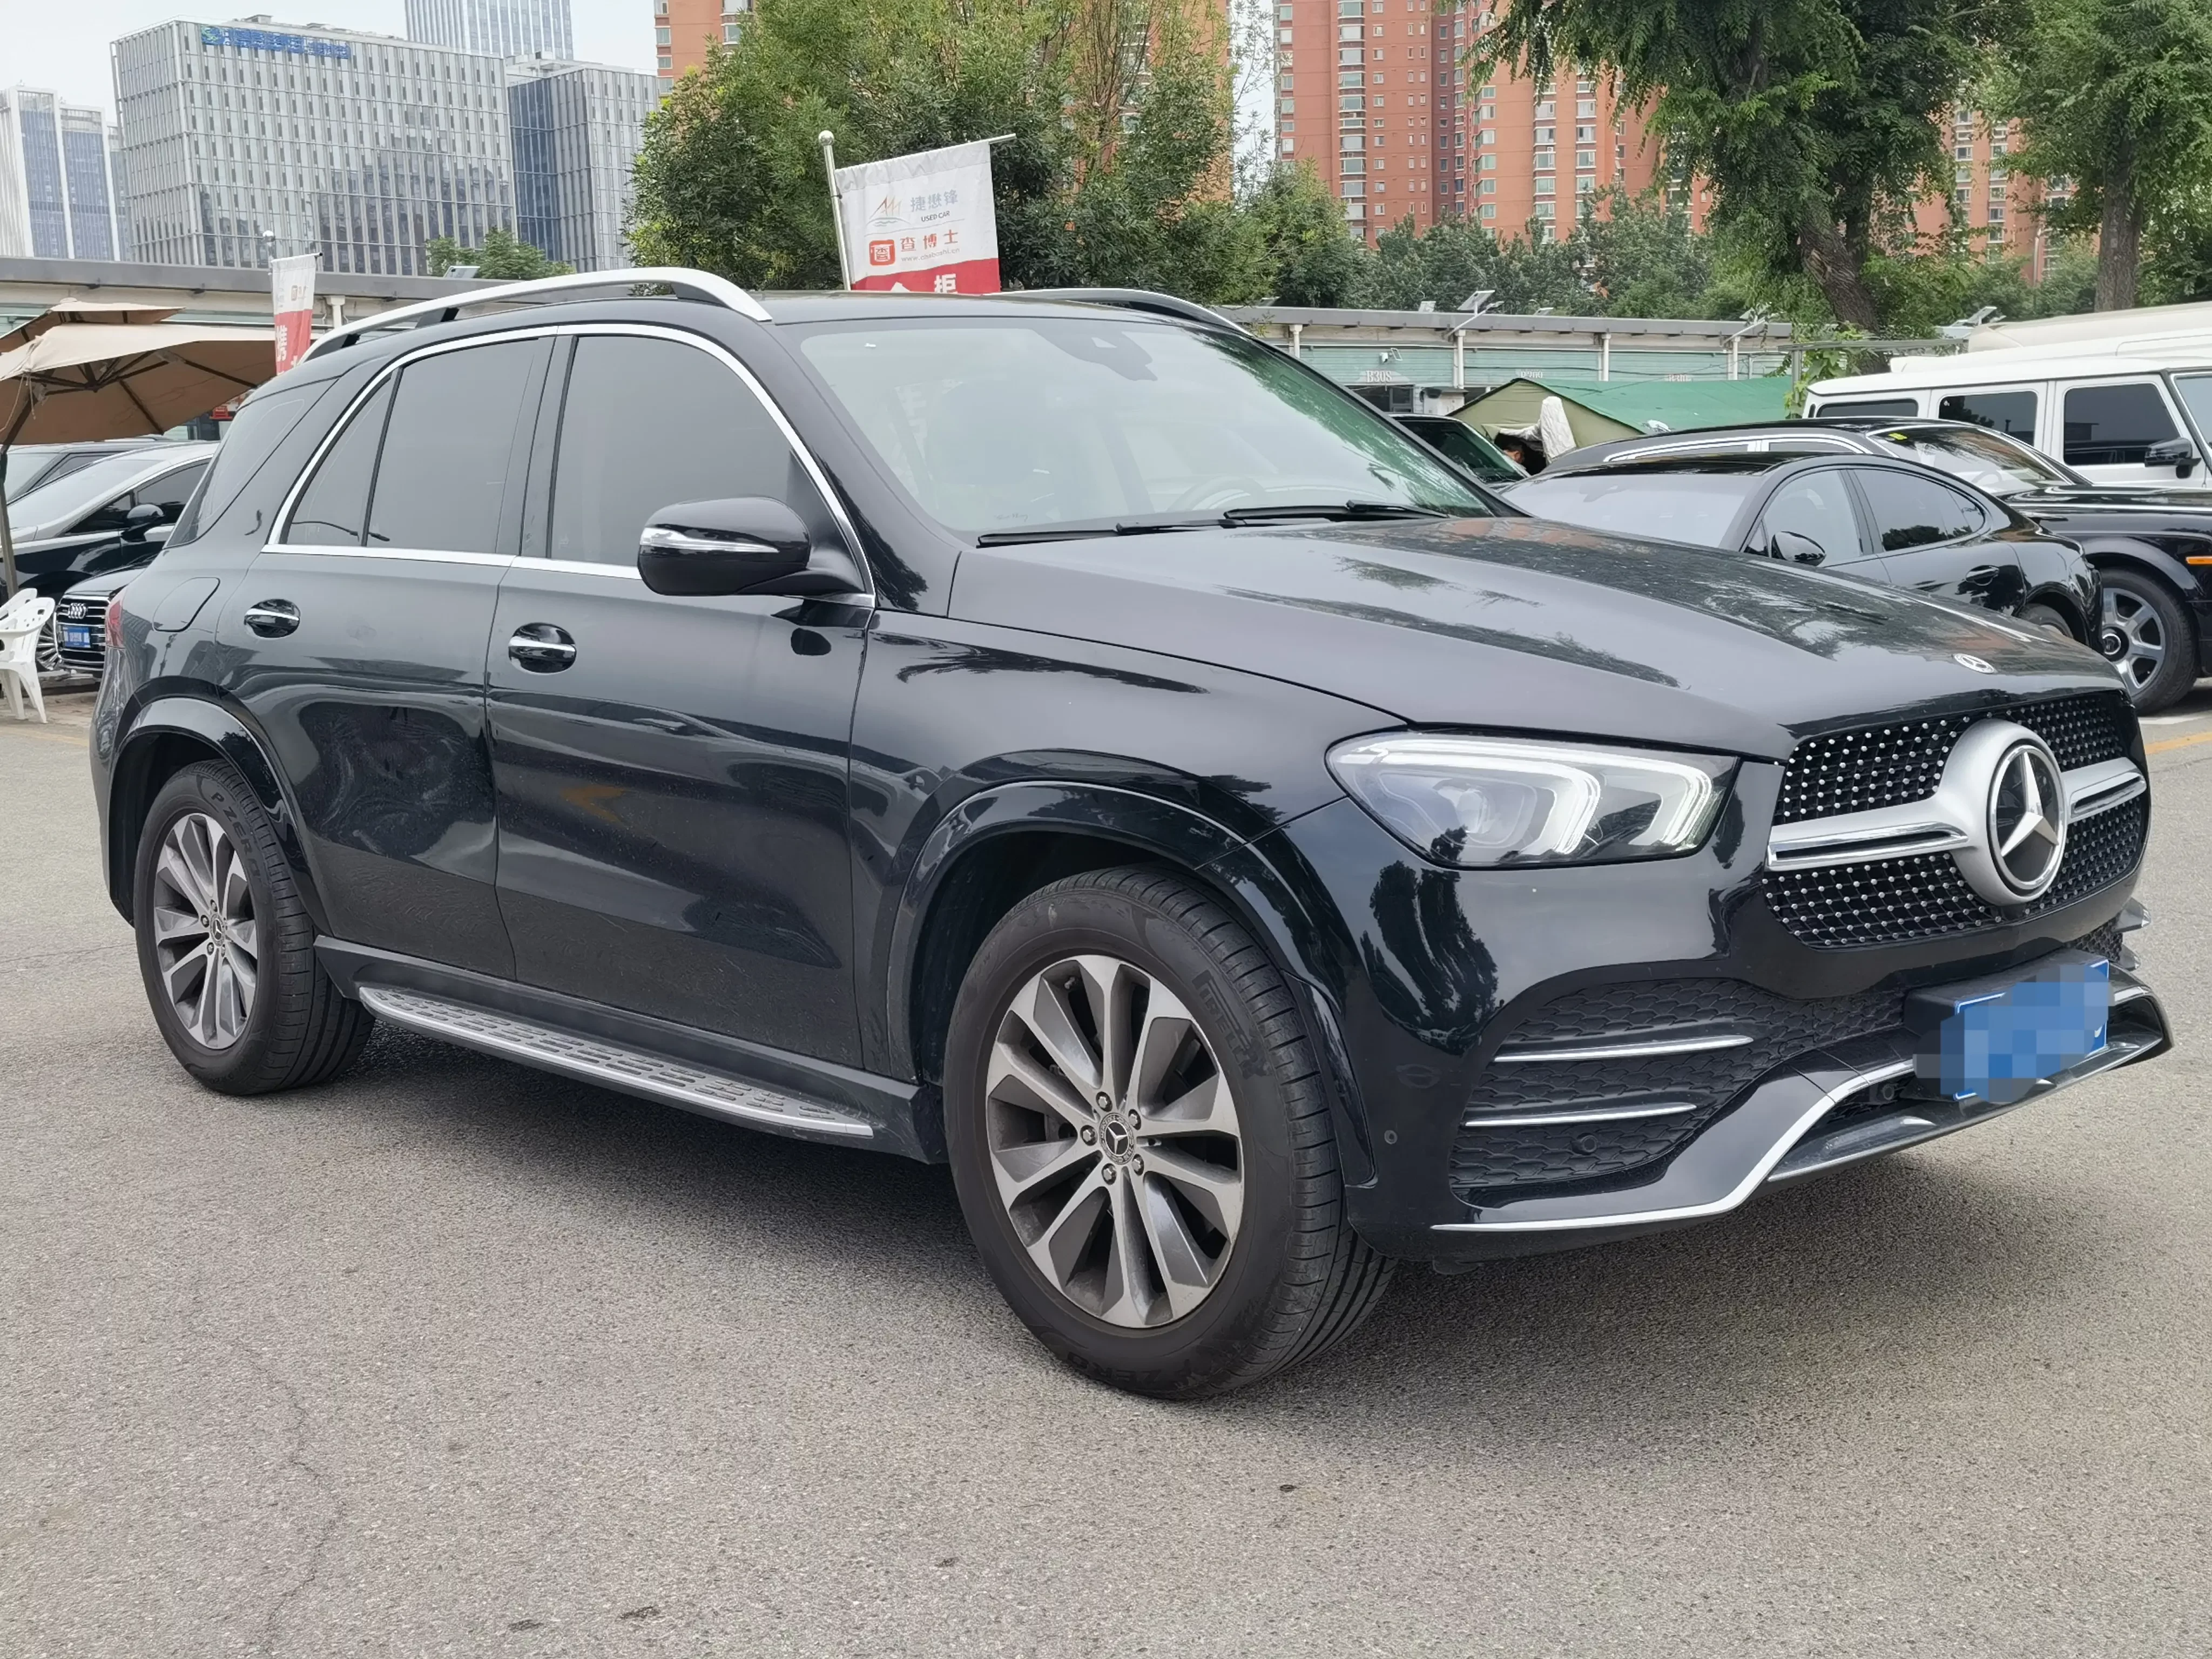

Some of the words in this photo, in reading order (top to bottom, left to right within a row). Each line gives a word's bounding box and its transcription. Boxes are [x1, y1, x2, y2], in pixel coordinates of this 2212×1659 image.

[921, 214, 938, 222] USED
[938, 210, 950, 219] CAR
[900, 228, 959, 252] 查博士
[211, 792, 225, 802] P
[222, 805, 261, 877] ZERO
